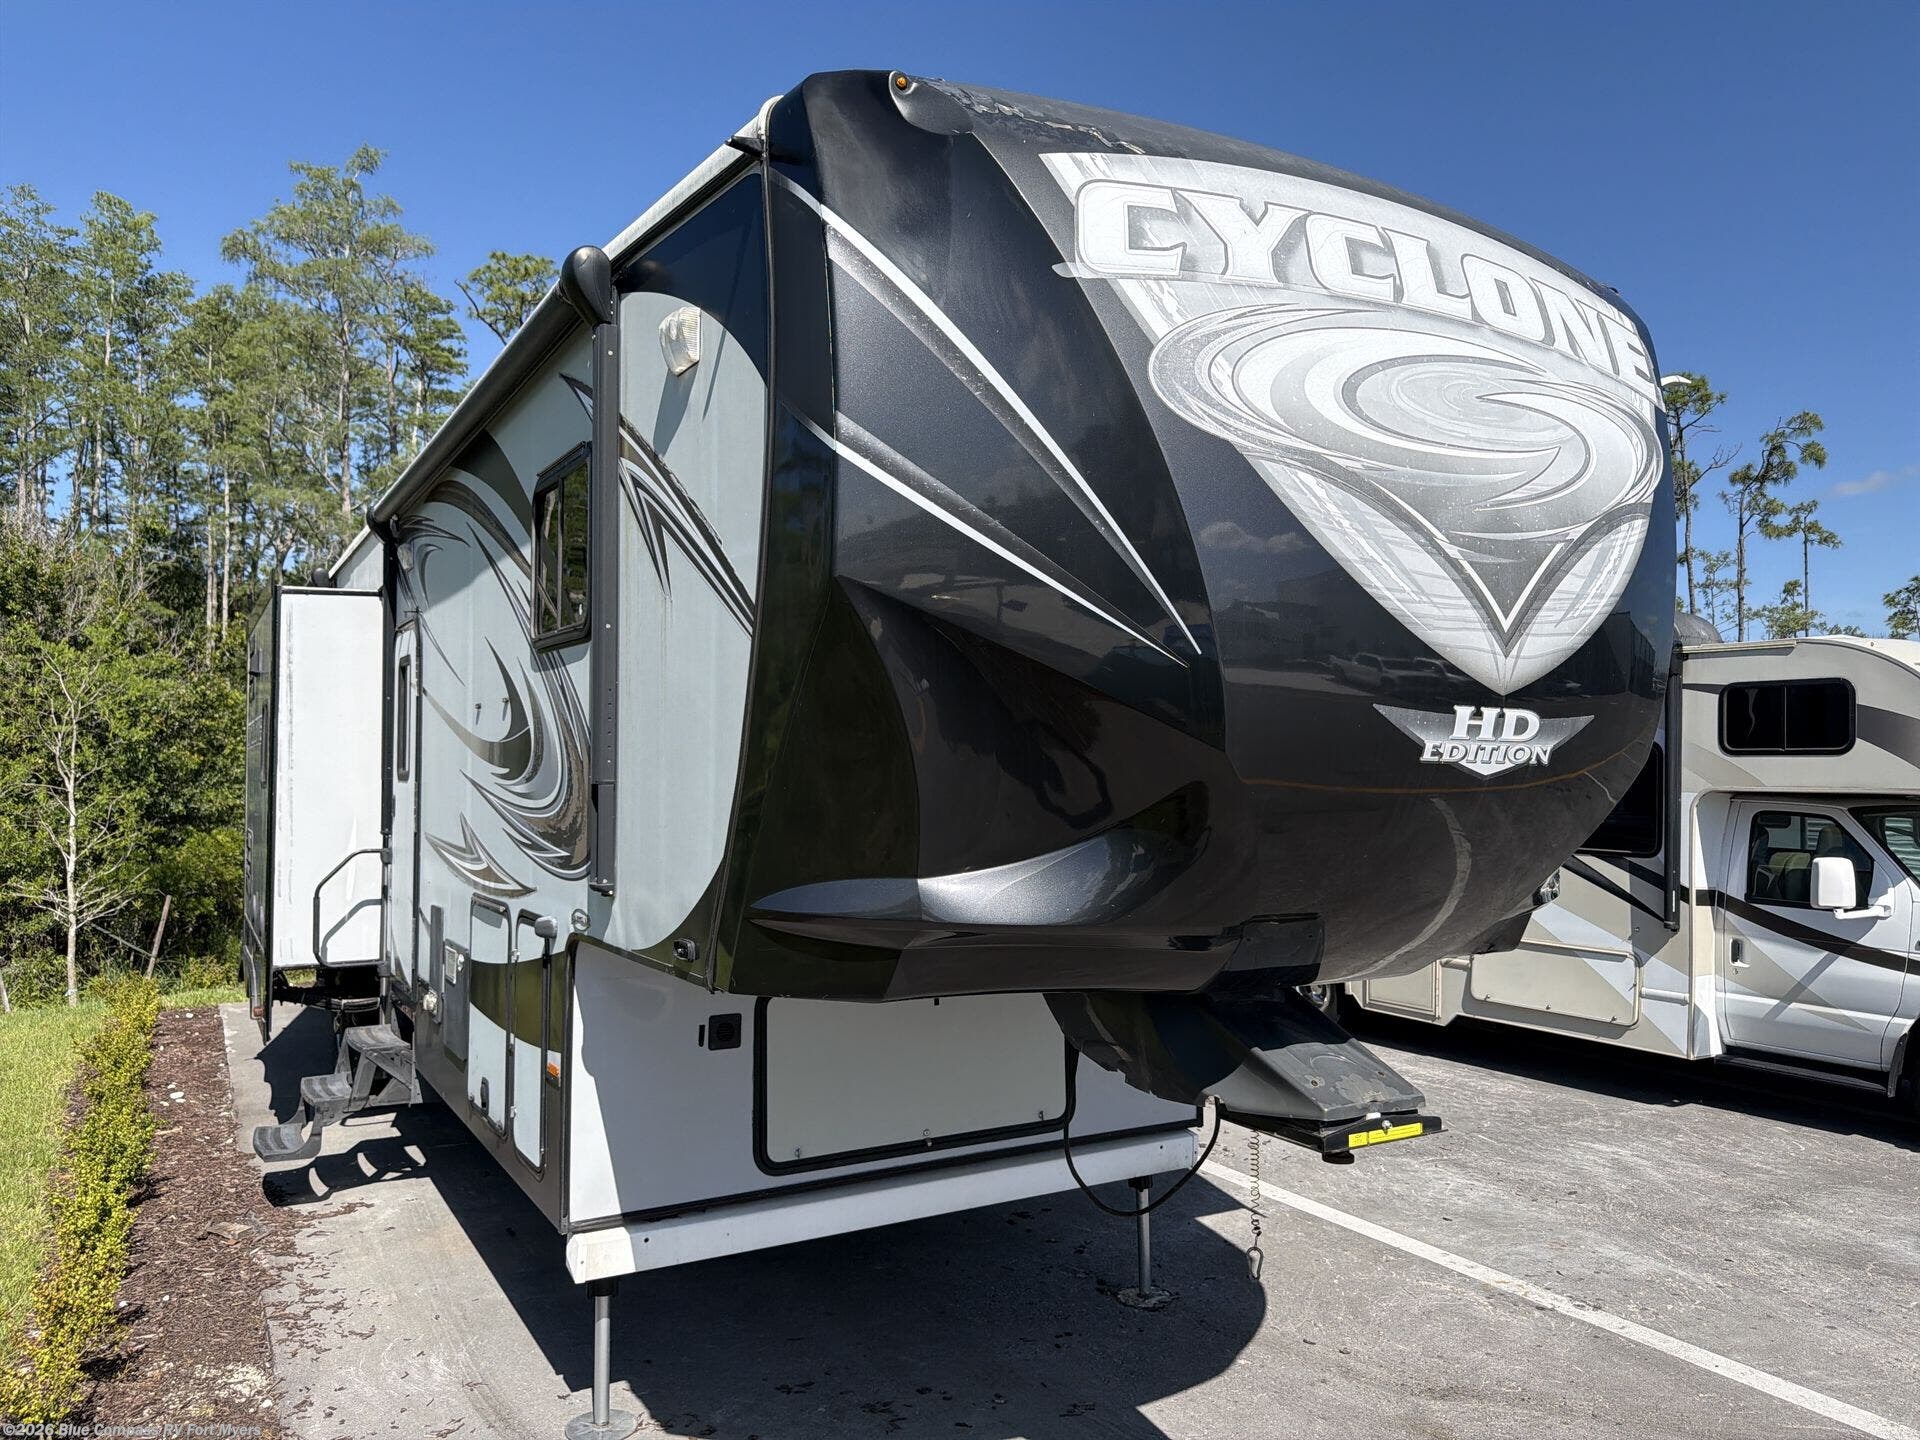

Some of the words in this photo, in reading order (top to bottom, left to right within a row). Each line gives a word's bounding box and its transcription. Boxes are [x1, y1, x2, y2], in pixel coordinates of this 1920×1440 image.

[1074, 178, 1657, 404] CYCLONE
[1450, 704, 1541, 742] HD
[1420, 741, 1553, 765] EDITION
